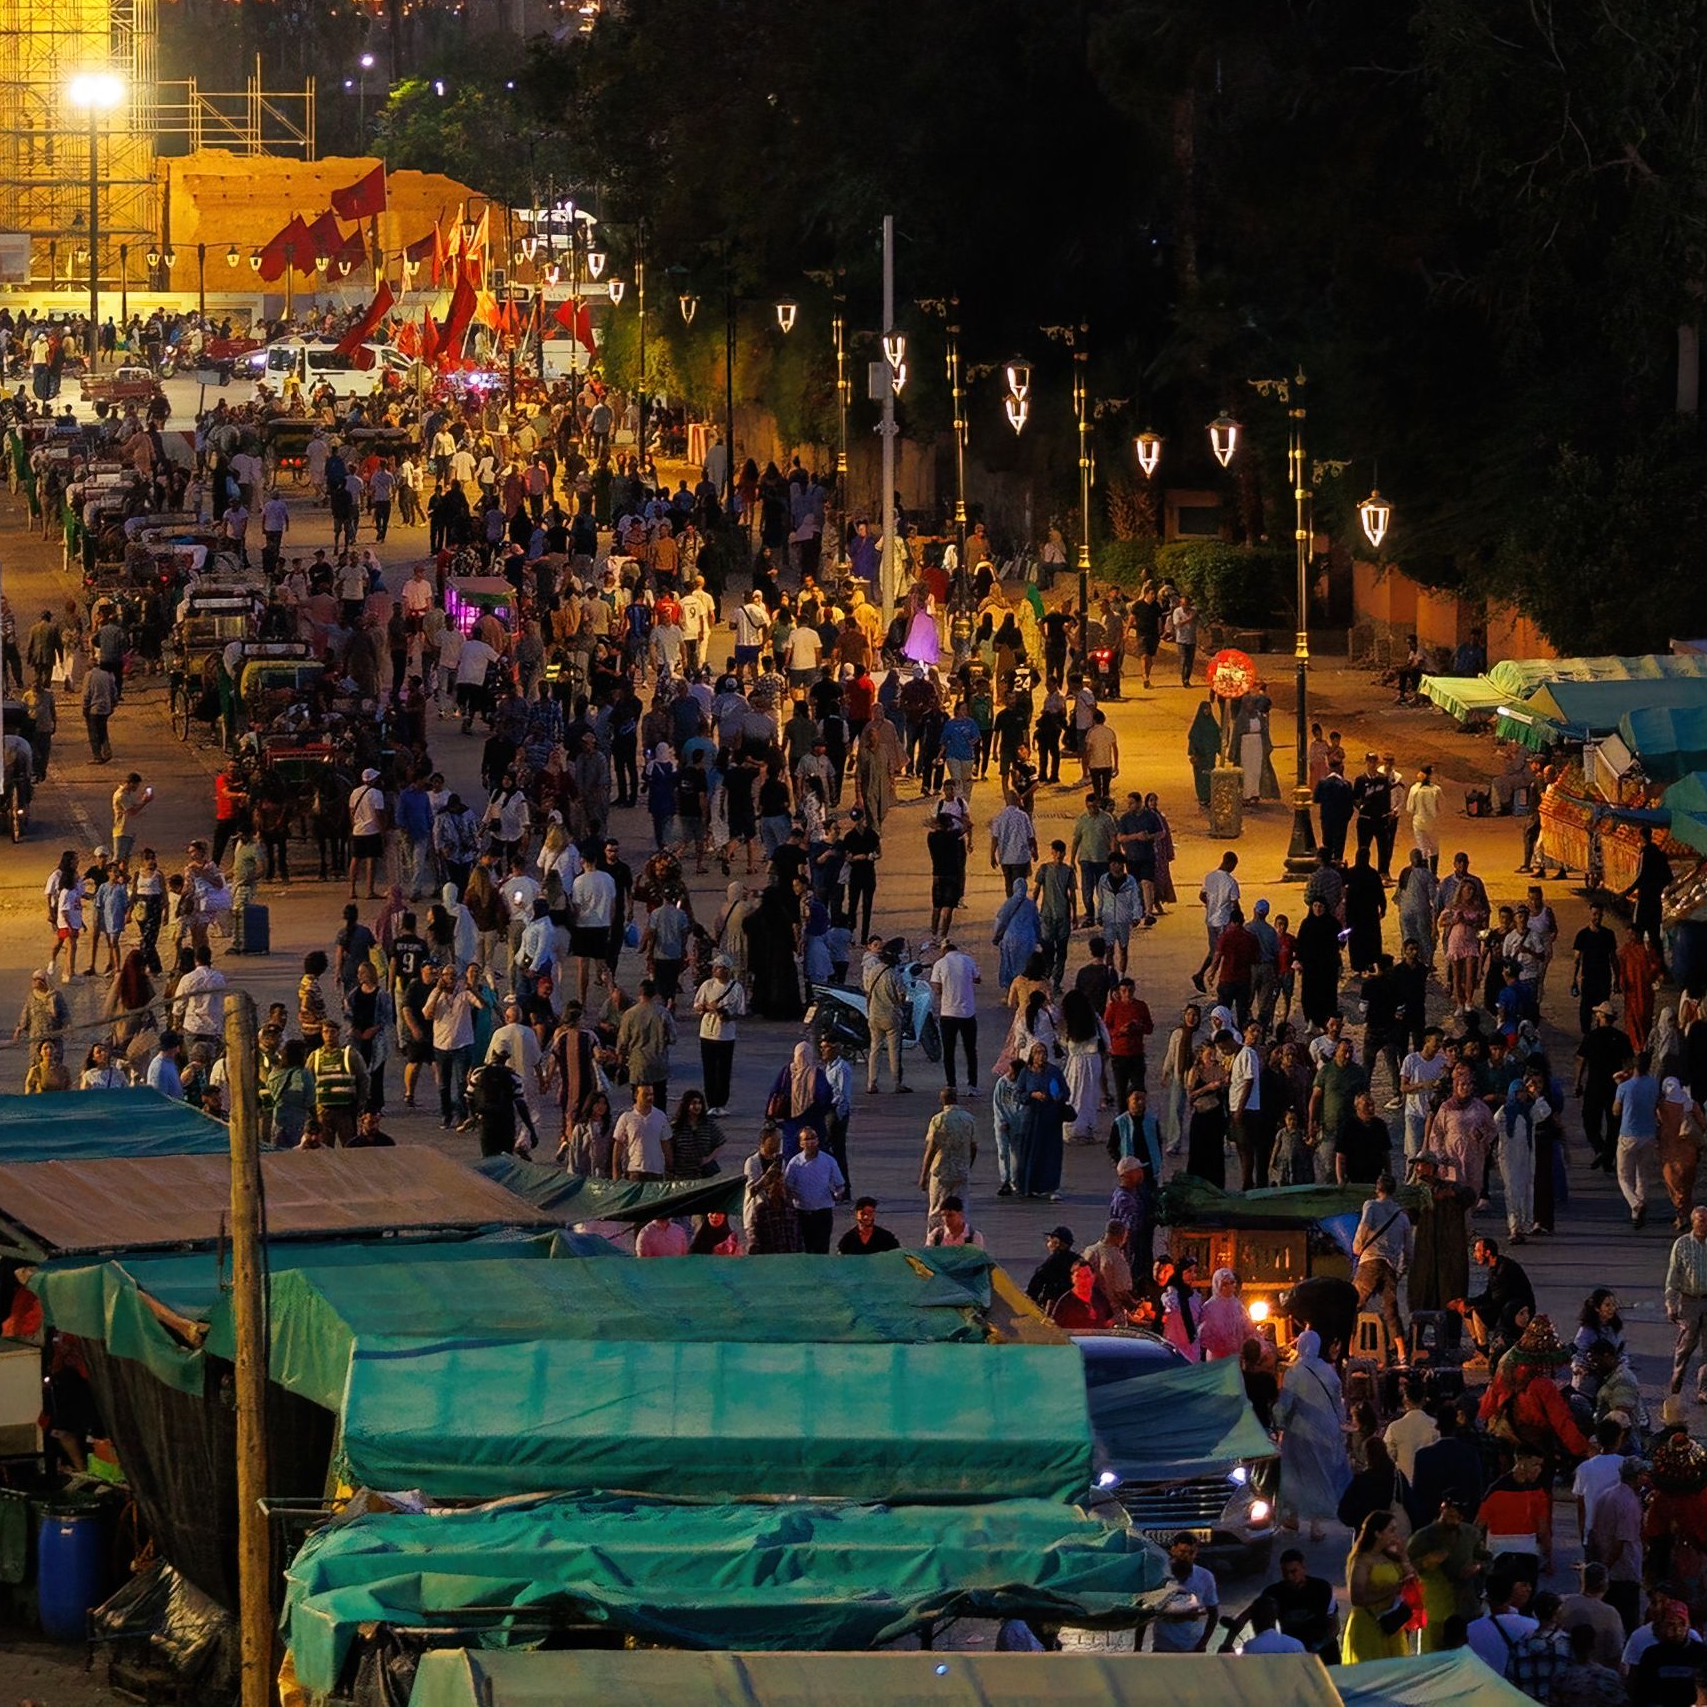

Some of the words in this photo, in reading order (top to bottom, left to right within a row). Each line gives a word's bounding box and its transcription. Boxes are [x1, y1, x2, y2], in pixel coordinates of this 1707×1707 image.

[689, 606, 696, 619] 9
[1013, 675, 1031, 692] 24
[402, 952, 414, 974] 9
